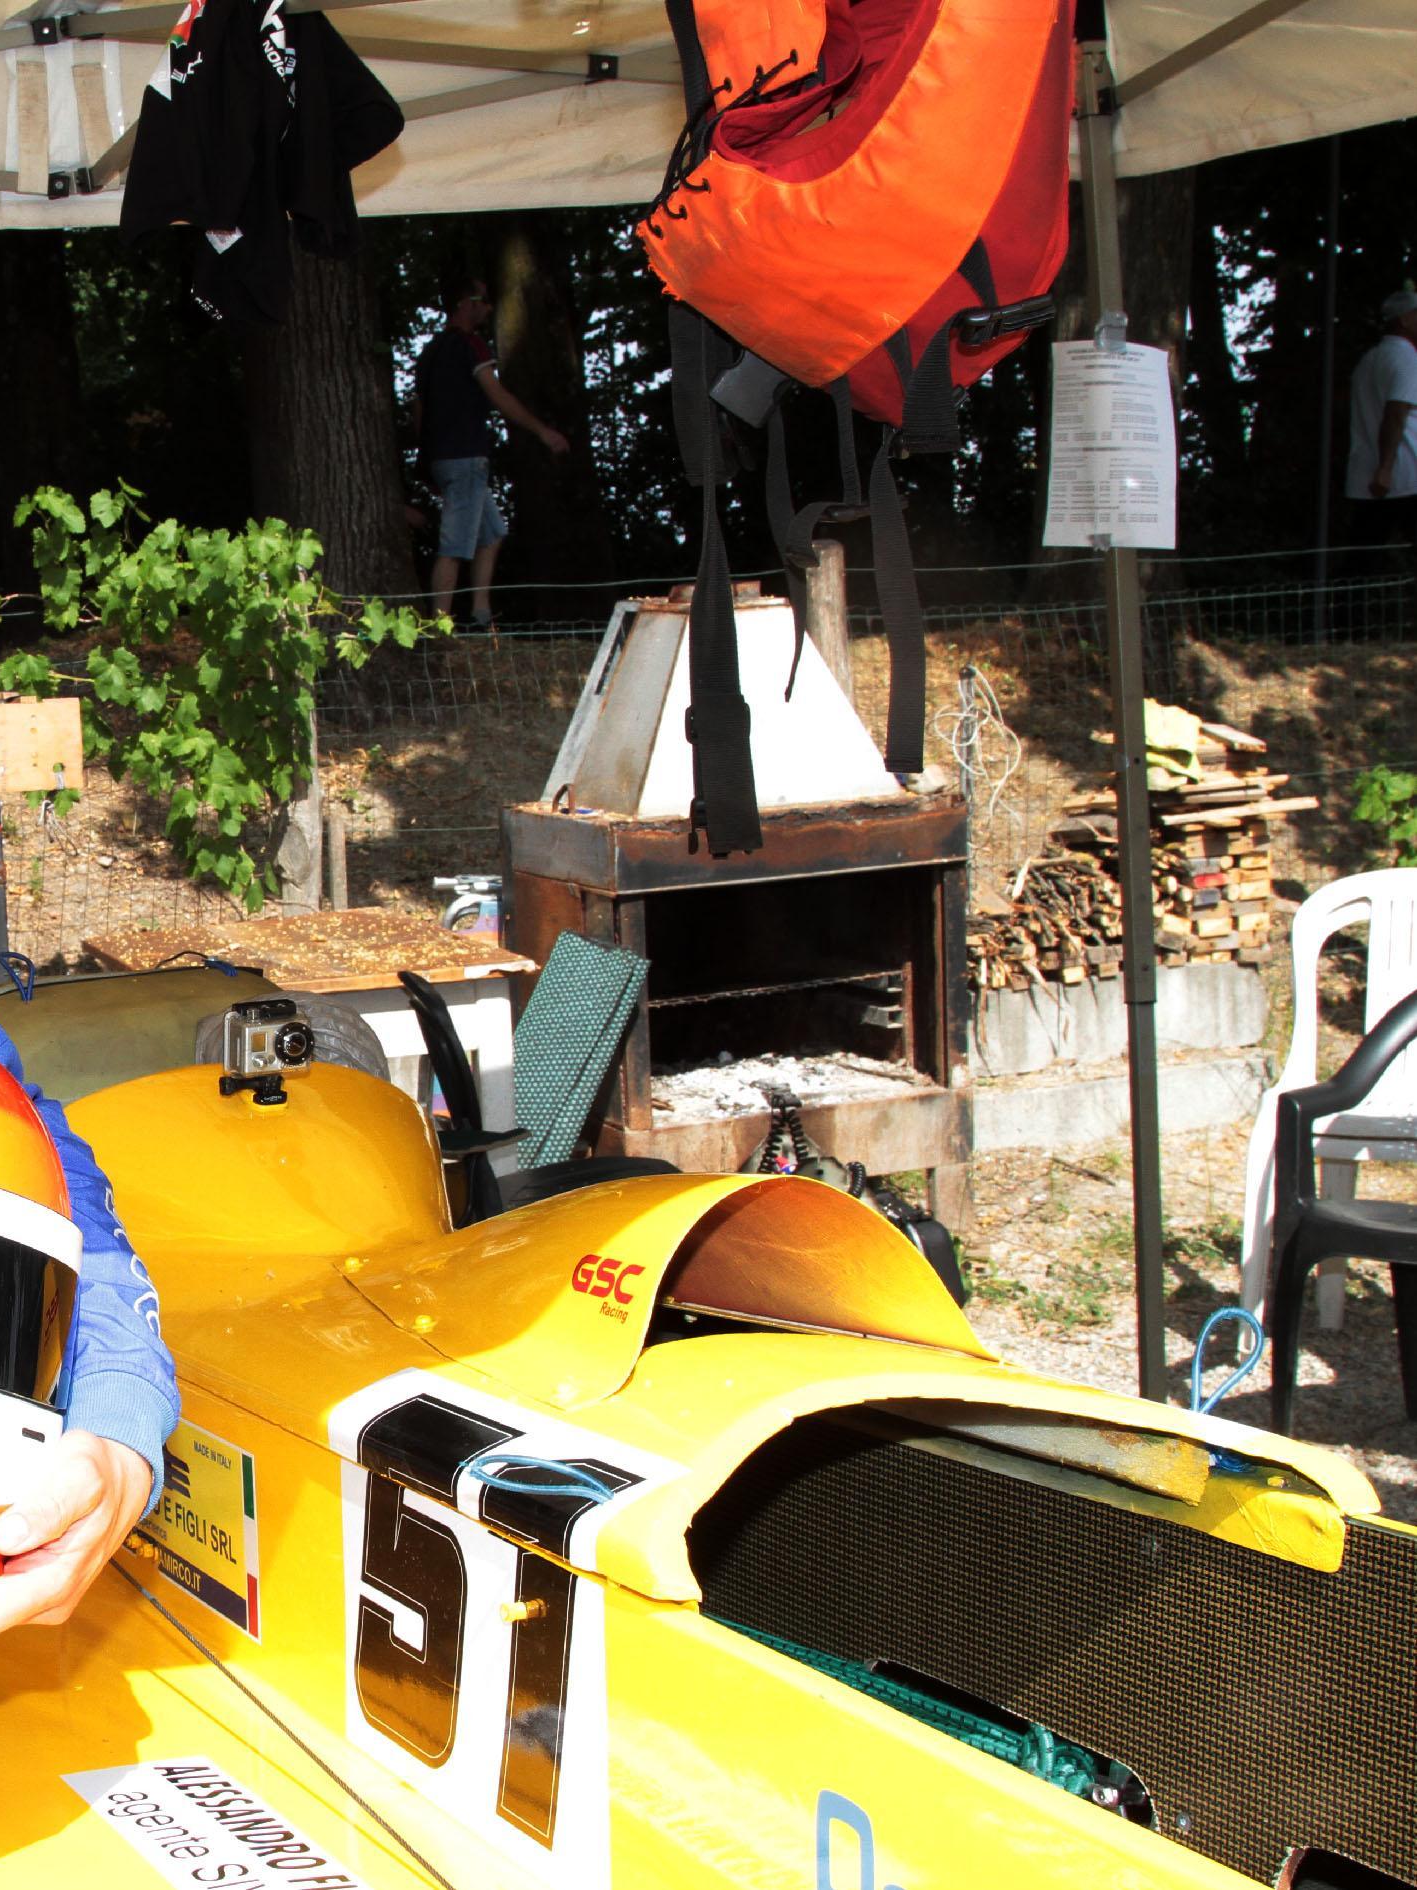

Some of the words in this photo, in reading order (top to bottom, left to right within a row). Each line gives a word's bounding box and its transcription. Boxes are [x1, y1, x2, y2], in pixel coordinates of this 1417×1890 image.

[571, 1254, 646, 1305] GSC
[599, 1301, 628, 1324] Racing
[194, 1440, 210, 1459] MADE
[216, 1453, 232, 1470] ITALY
[175, 1502, 207, 1546] FIGLI
[210, 1525, 237, 1565] SRL
[355, 1393, 647, 1852] 51
[107, 1791, 210, 1859] agente
[153, 1766, 327, 1870] ALESSANDRO
